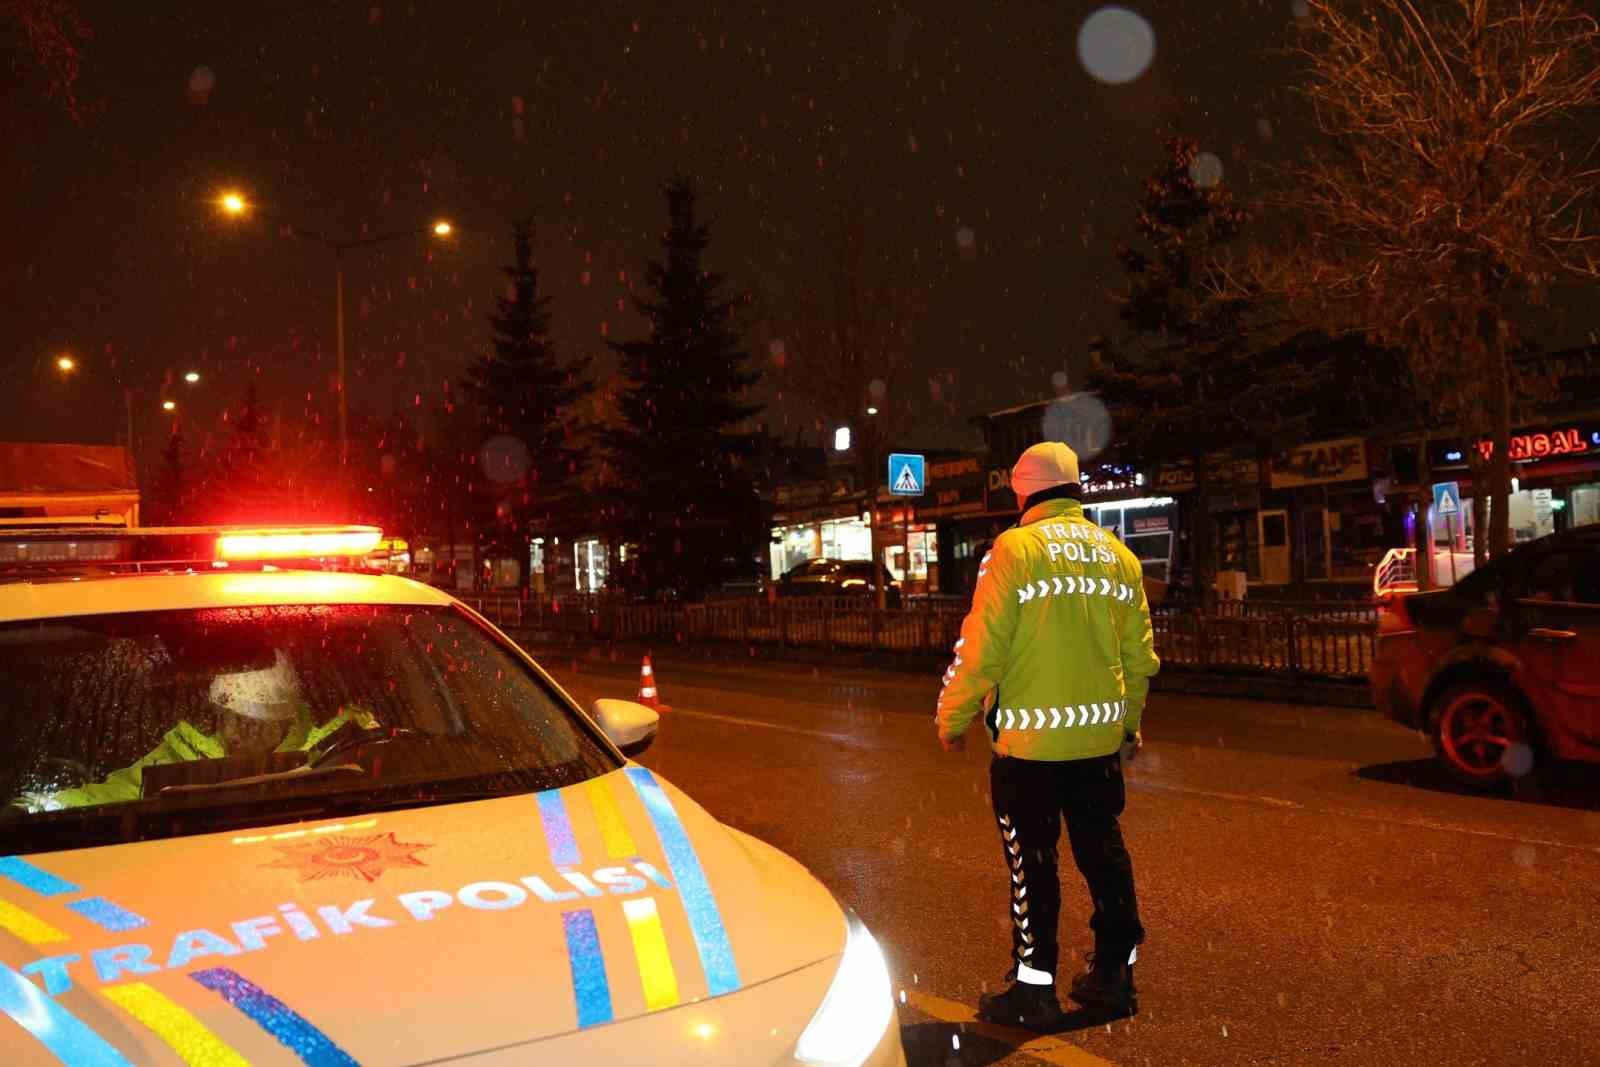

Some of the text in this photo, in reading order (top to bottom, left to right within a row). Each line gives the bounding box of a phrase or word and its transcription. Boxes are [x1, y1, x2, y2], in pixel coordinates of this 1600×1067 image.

[1472, 429, 1587, 461] MNGAL
[1047, 541, 1118, 564] POLİSİ
[20, 857, 673, 997] TRAFİK POLİSİ
